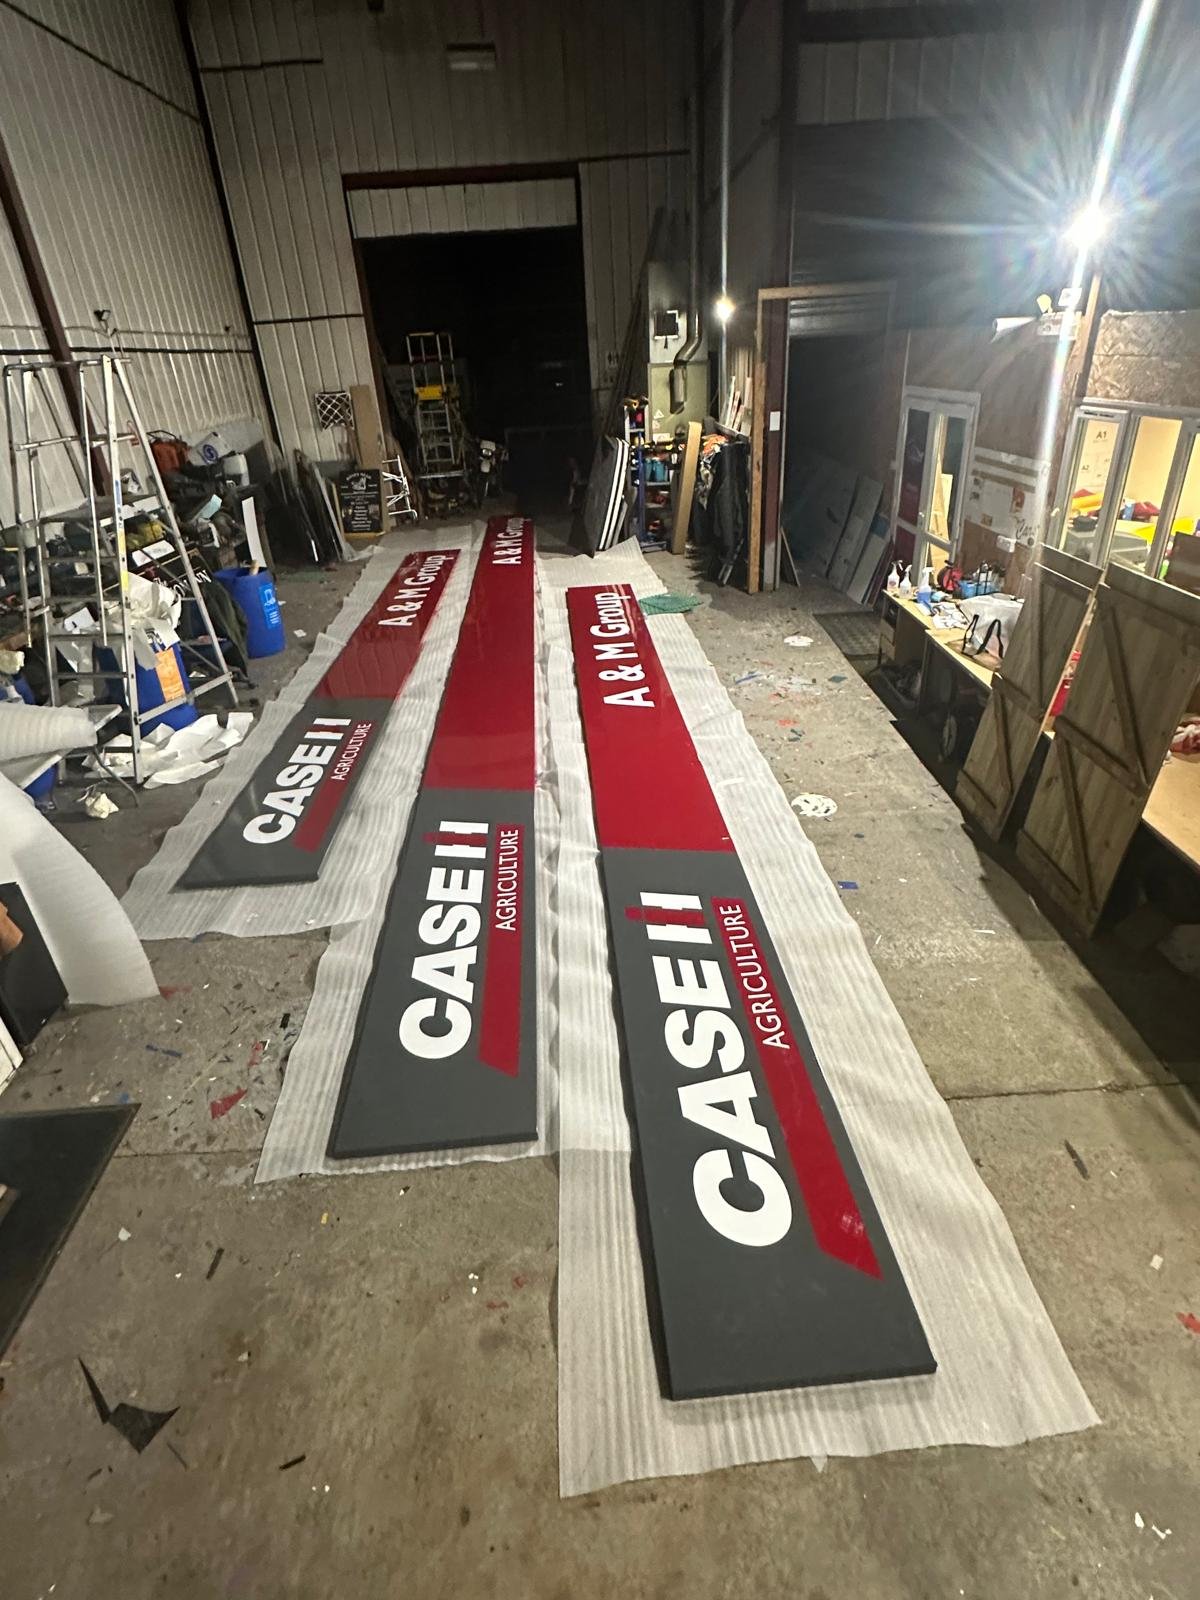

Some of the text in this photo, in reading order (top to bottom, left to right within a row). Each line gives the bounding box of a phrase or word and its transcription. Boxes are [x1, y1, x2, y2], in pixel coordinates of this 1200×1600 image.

[1096, 431, 1107, 439] A1
[492, 555, 522, 565] A
[493, 547, 522, 556] &
[495, 539, 522, 548] M
[378, 554, 455, 627] A & M Group
[589, 592, 655, 707] A & M Group
[243, 744, 337, 844] CASE
[330, 723, 372, 781] AGRICULTURE
[495, 829, 519, 932] AGRICULTURE
[399, 867, 485, 1060] CASE
[720, 904, 790, 1050] AGRICULTURE
[652, 955, 794, 1247] CASE
